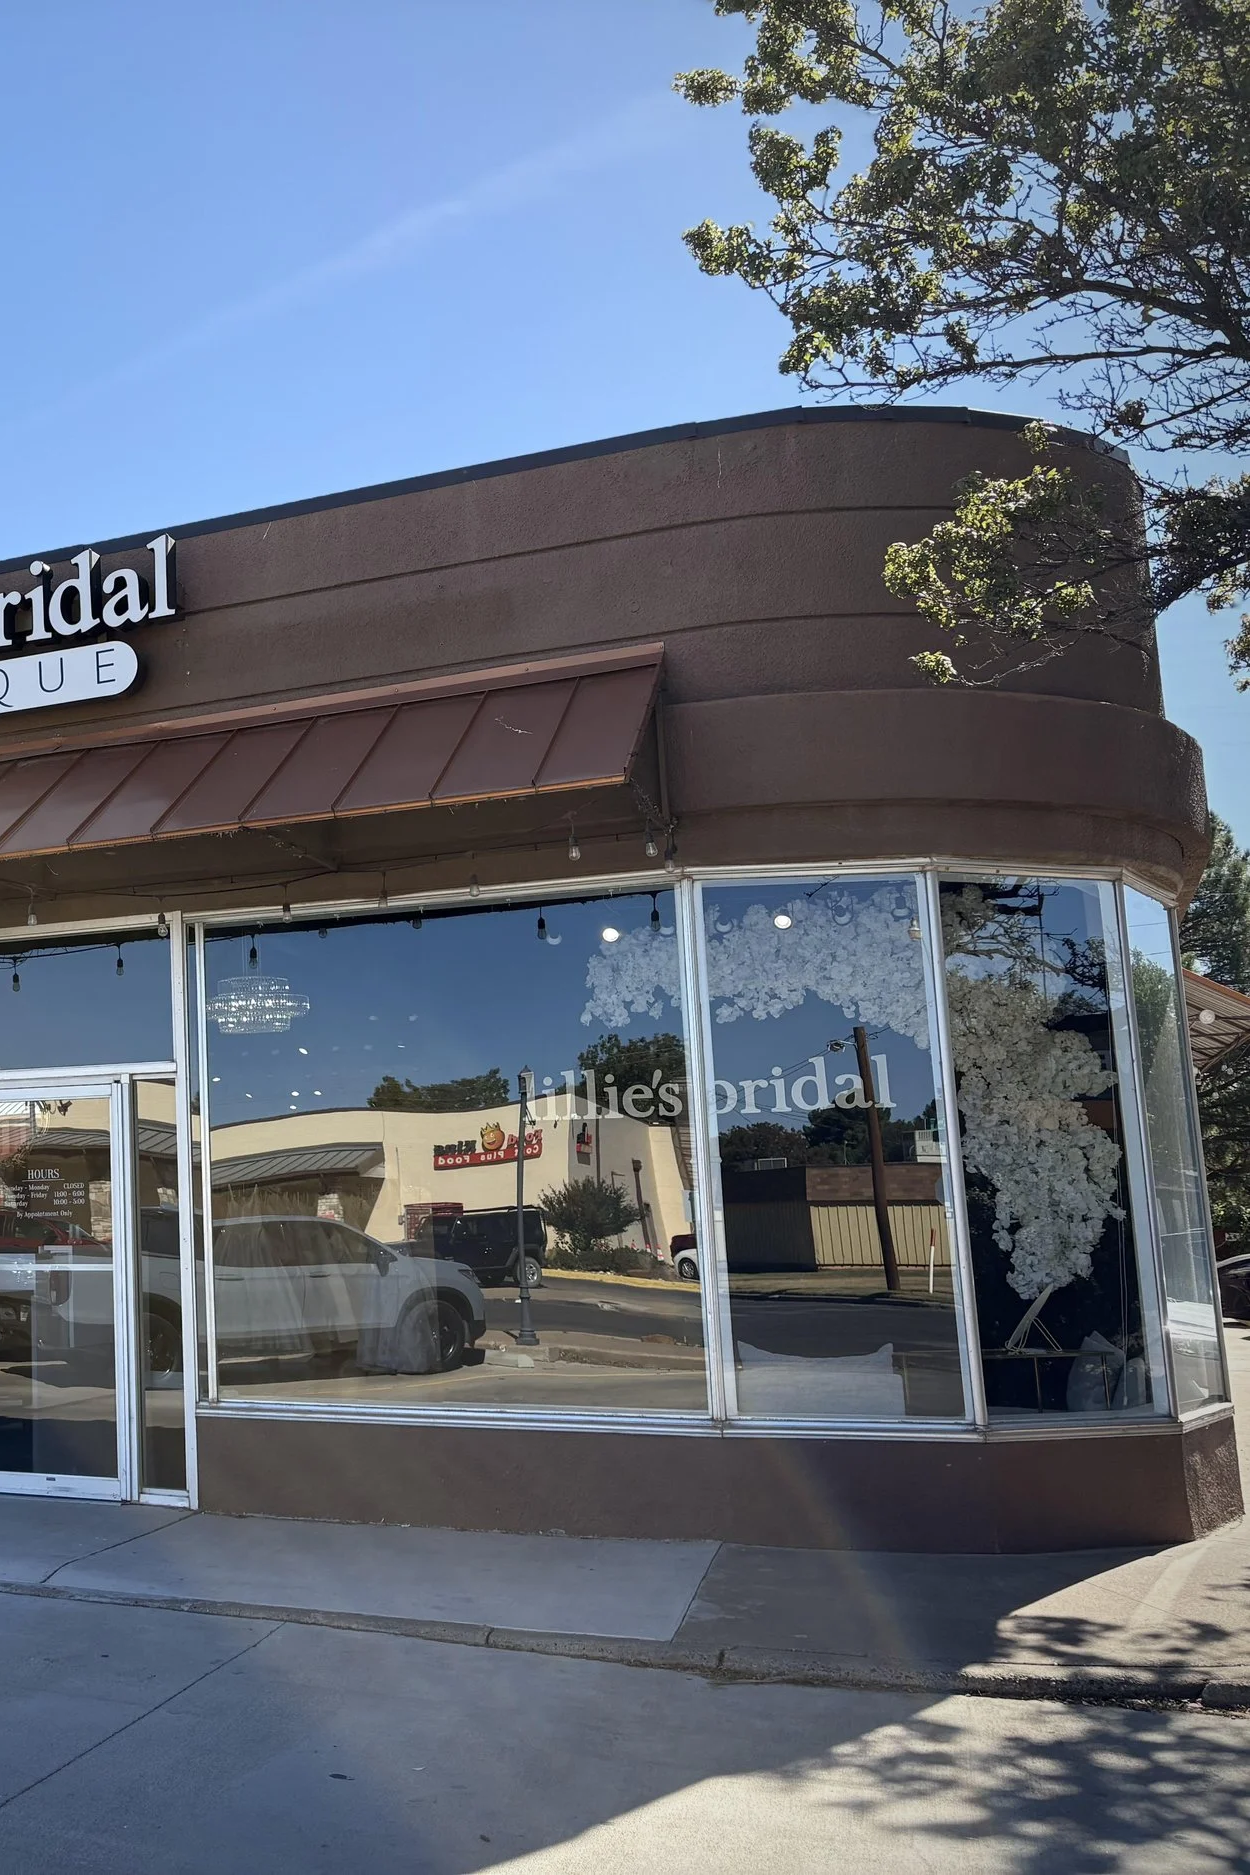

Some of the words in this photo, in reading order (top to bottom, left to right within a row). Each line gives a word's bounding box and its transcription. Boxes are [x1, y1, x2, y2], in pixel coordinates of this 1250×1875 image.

[27, 1168, 60, 1180] HOURS
[29, 1184, 50, 1192] Monday
[24, 1210, 59, 1219] Appointment
[60, 1209, 73, 1217] Only
